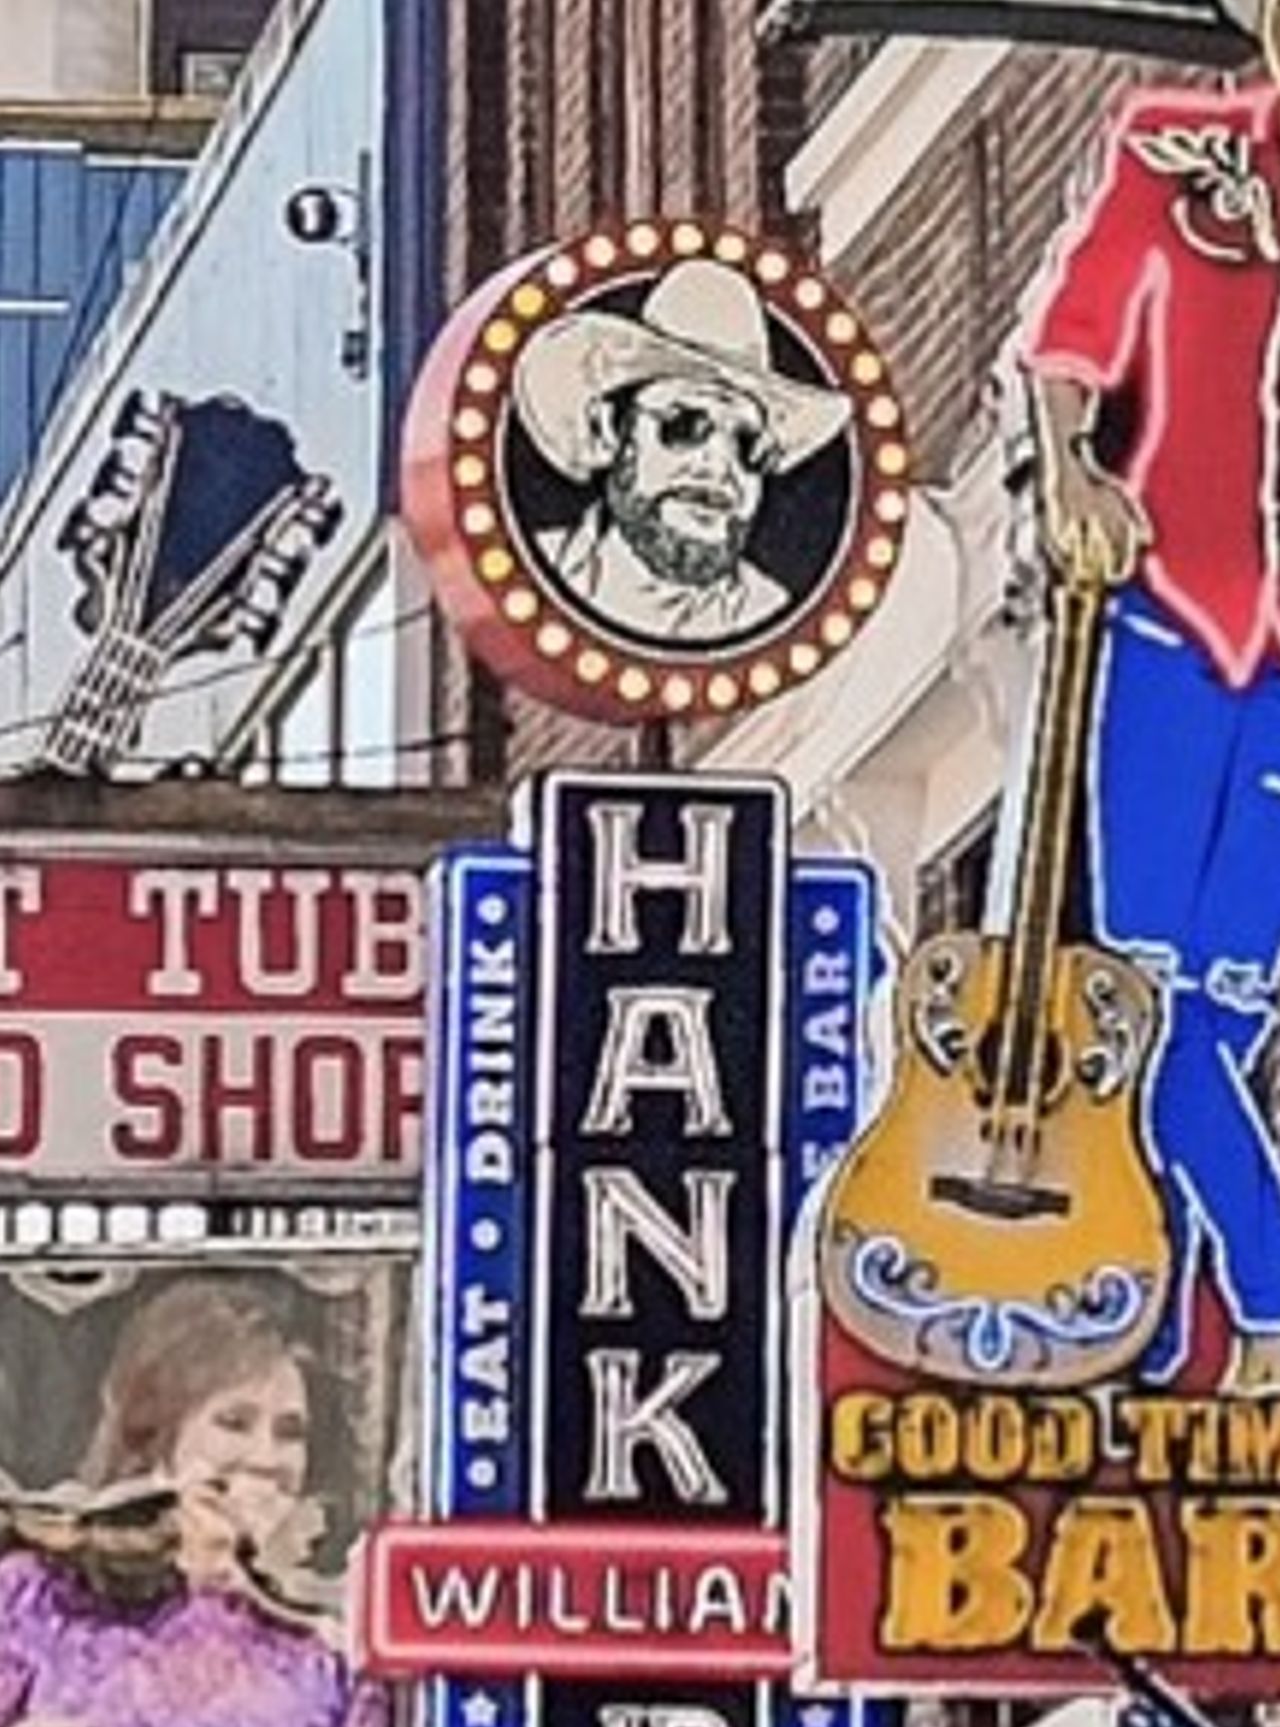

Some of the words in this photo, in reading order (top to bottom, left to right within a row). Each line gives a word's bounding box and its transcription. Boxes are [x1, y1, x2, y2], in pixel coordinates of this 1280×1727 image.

[466, 938, 515, 1184] DRINK
[803, 951, 850, 1114] BAR
[580, 803, 732, 1503] HANK
[461, 1284, 509, 1444] EAT
[831, 1393, 1093, 1480] GOOD
